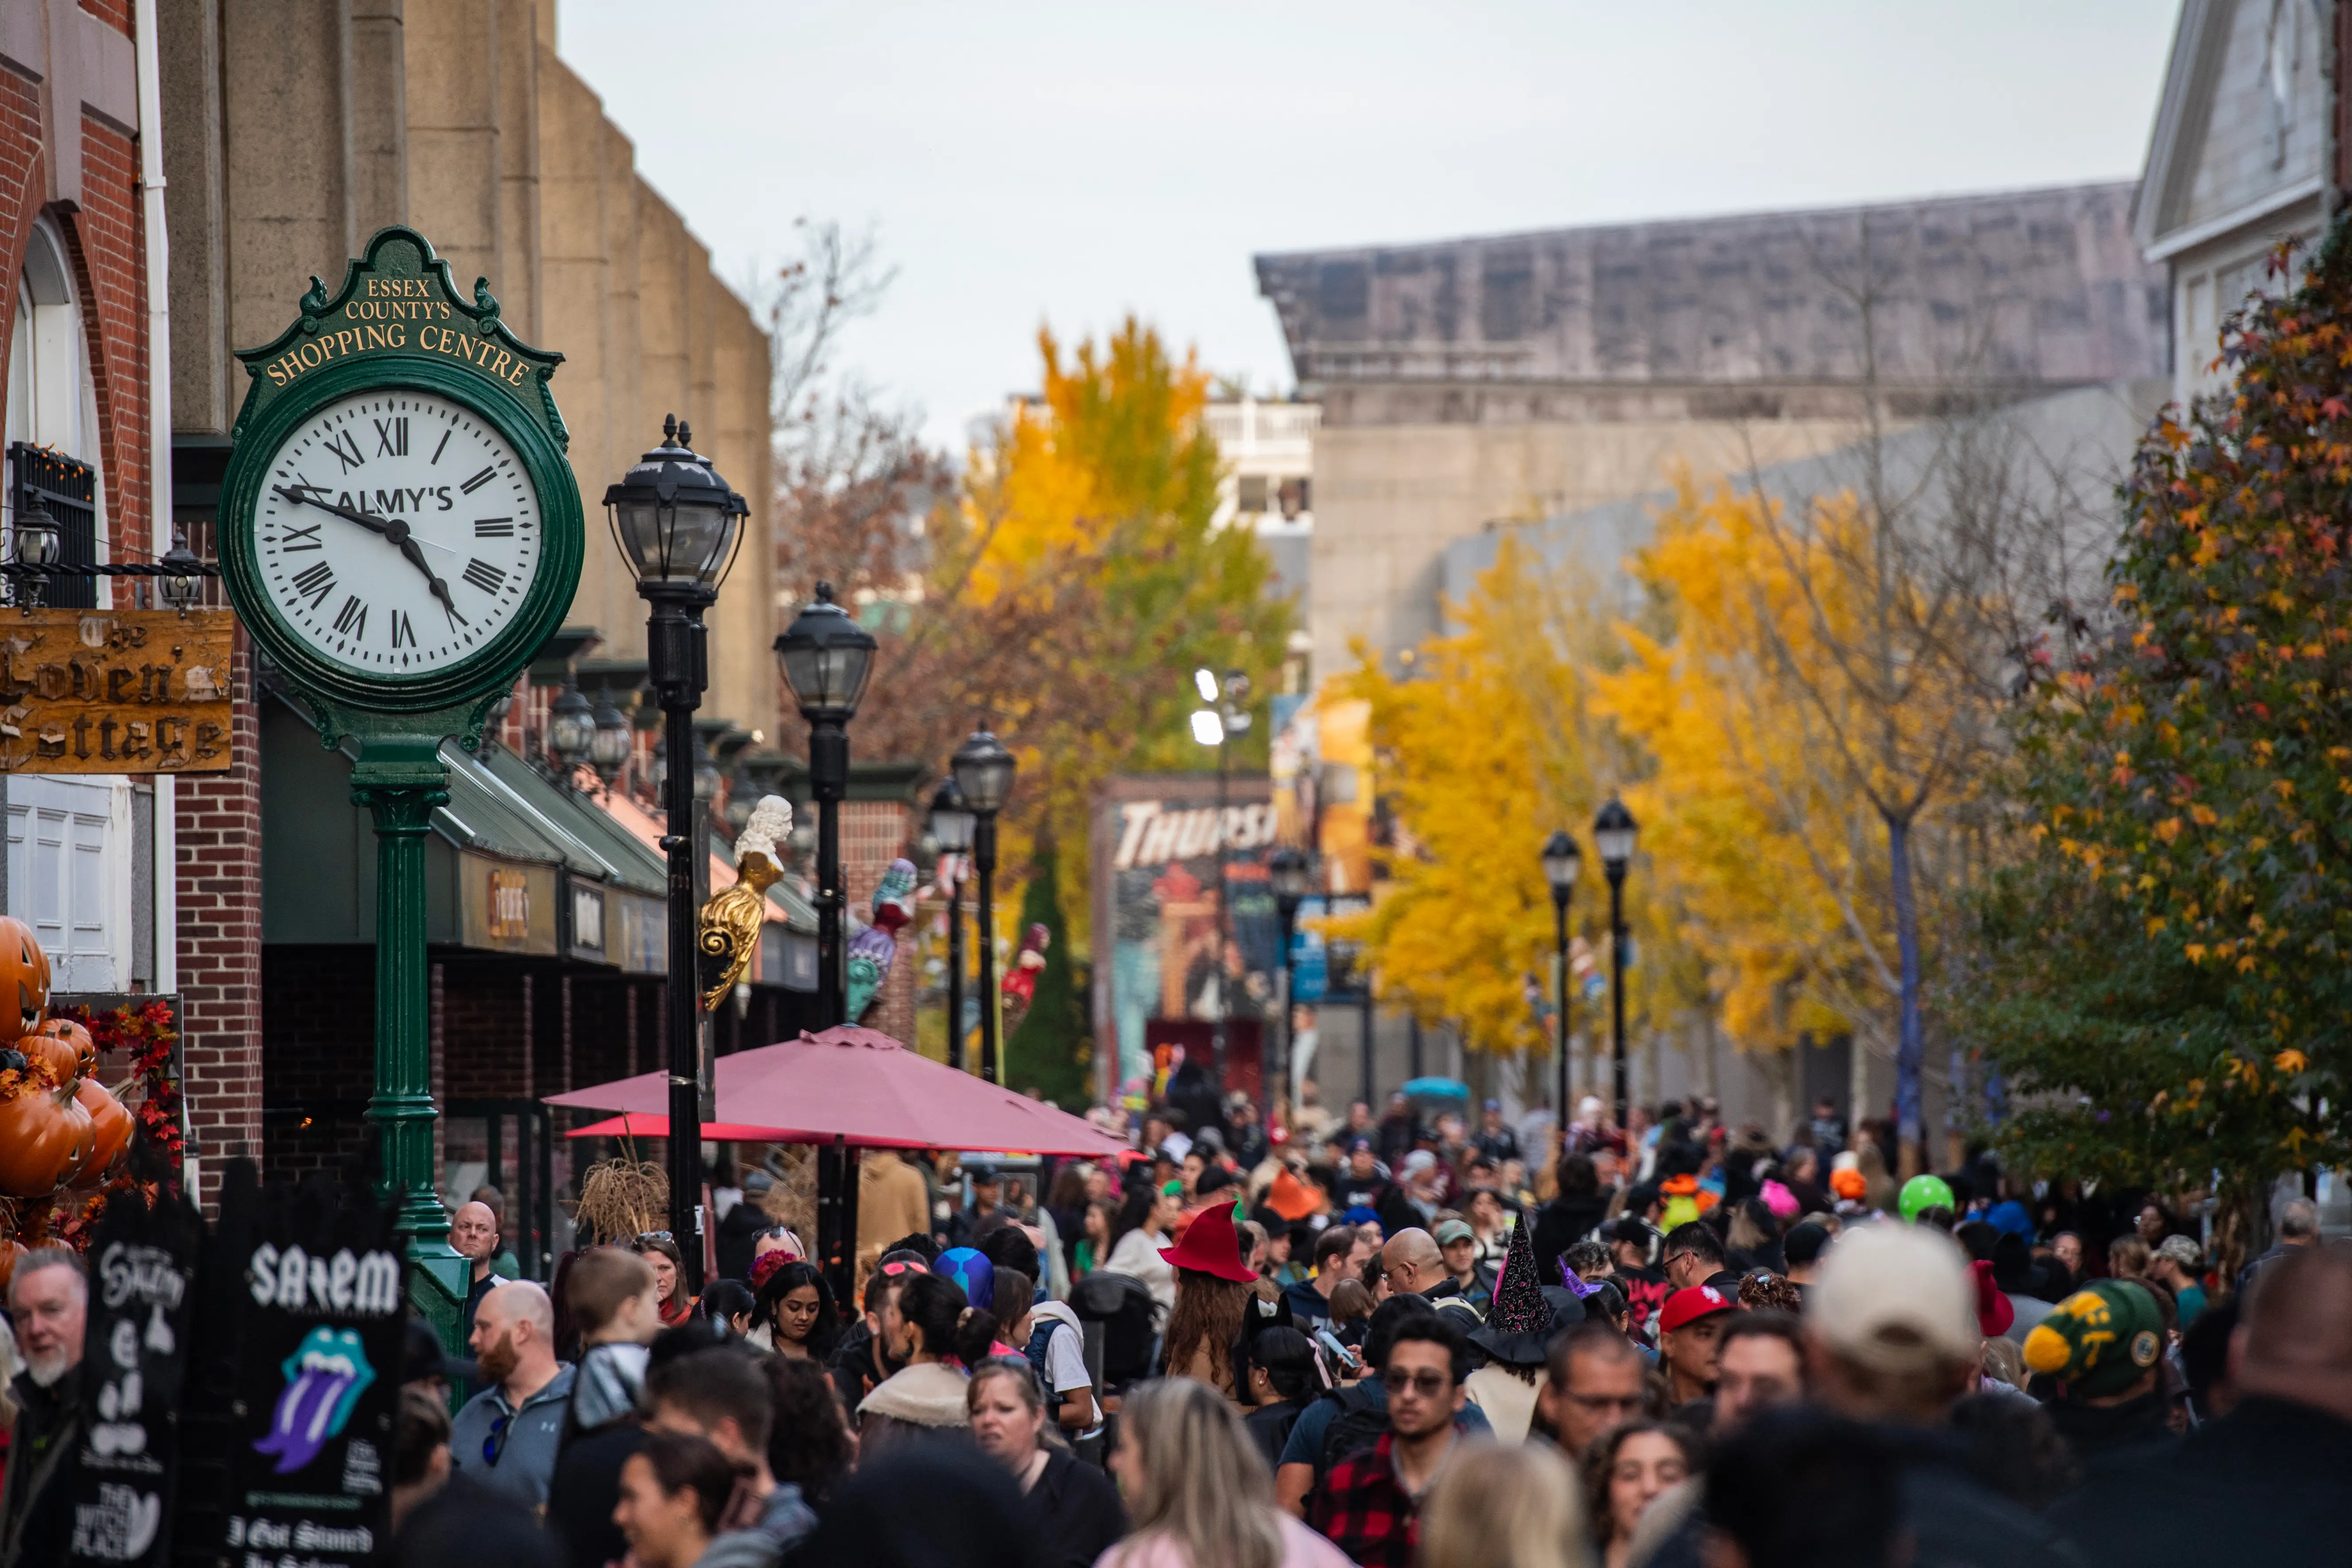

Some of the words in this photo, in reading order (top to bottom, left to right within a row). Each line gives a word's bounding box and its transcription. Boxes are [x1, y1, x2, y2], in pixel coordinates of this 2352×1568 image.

[368, 280, 429, 297] ESSEX
[346, 302, 450, 319] COUNTY'S
[267, 324, 406, 387] SHOPPING
[420, 326, 530, 387] CENTRE
[373, 417, 408, 458] XII
[323, 429, 365, 476] XI
[335, 486, 453, 515] ALMY'S
[475, 517, 514, 538] III
